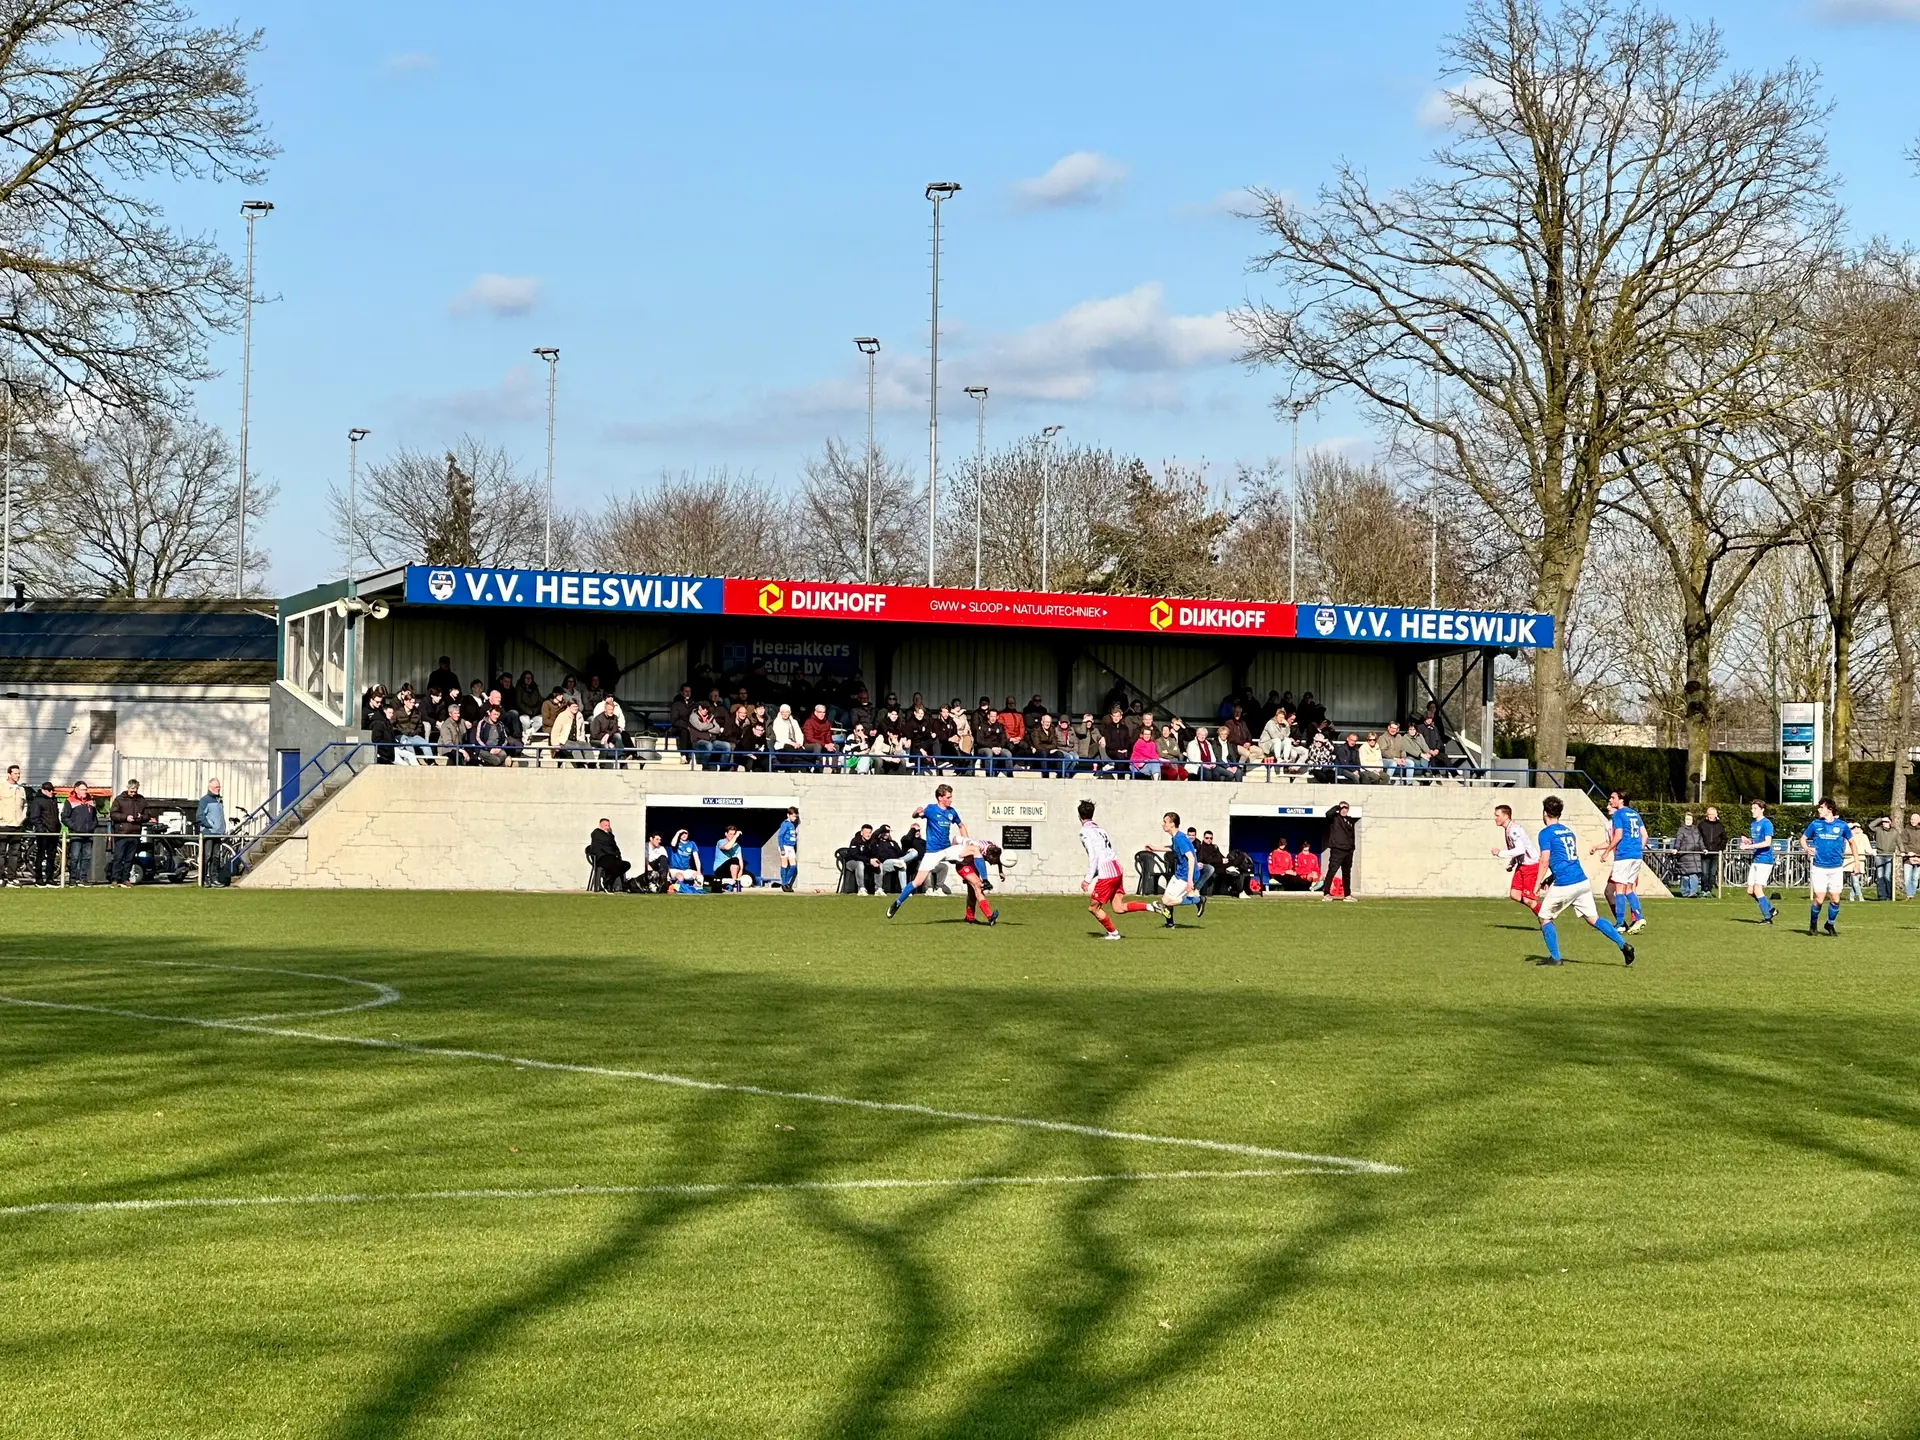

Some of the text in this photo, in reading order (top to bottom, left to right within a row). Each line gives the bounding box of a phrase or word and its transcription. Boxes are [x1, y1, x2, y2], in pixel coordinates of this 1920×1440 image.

[465, 572, 703, 609] V.V. HEESWIJK
[791, 591, 886, 613] DIJKHOFF
[929, 600, 1101, 618] GWW SLOOP NATUURTECHNIEK
[1179, 607, 1265, 628] DIJKHOFF
[1344, 610, 1537, 644] V.V. HEESWIJK
[752, 639, 850, 657] Heesakkers
[1020, 806, 1043, 815] TRIBUNE
